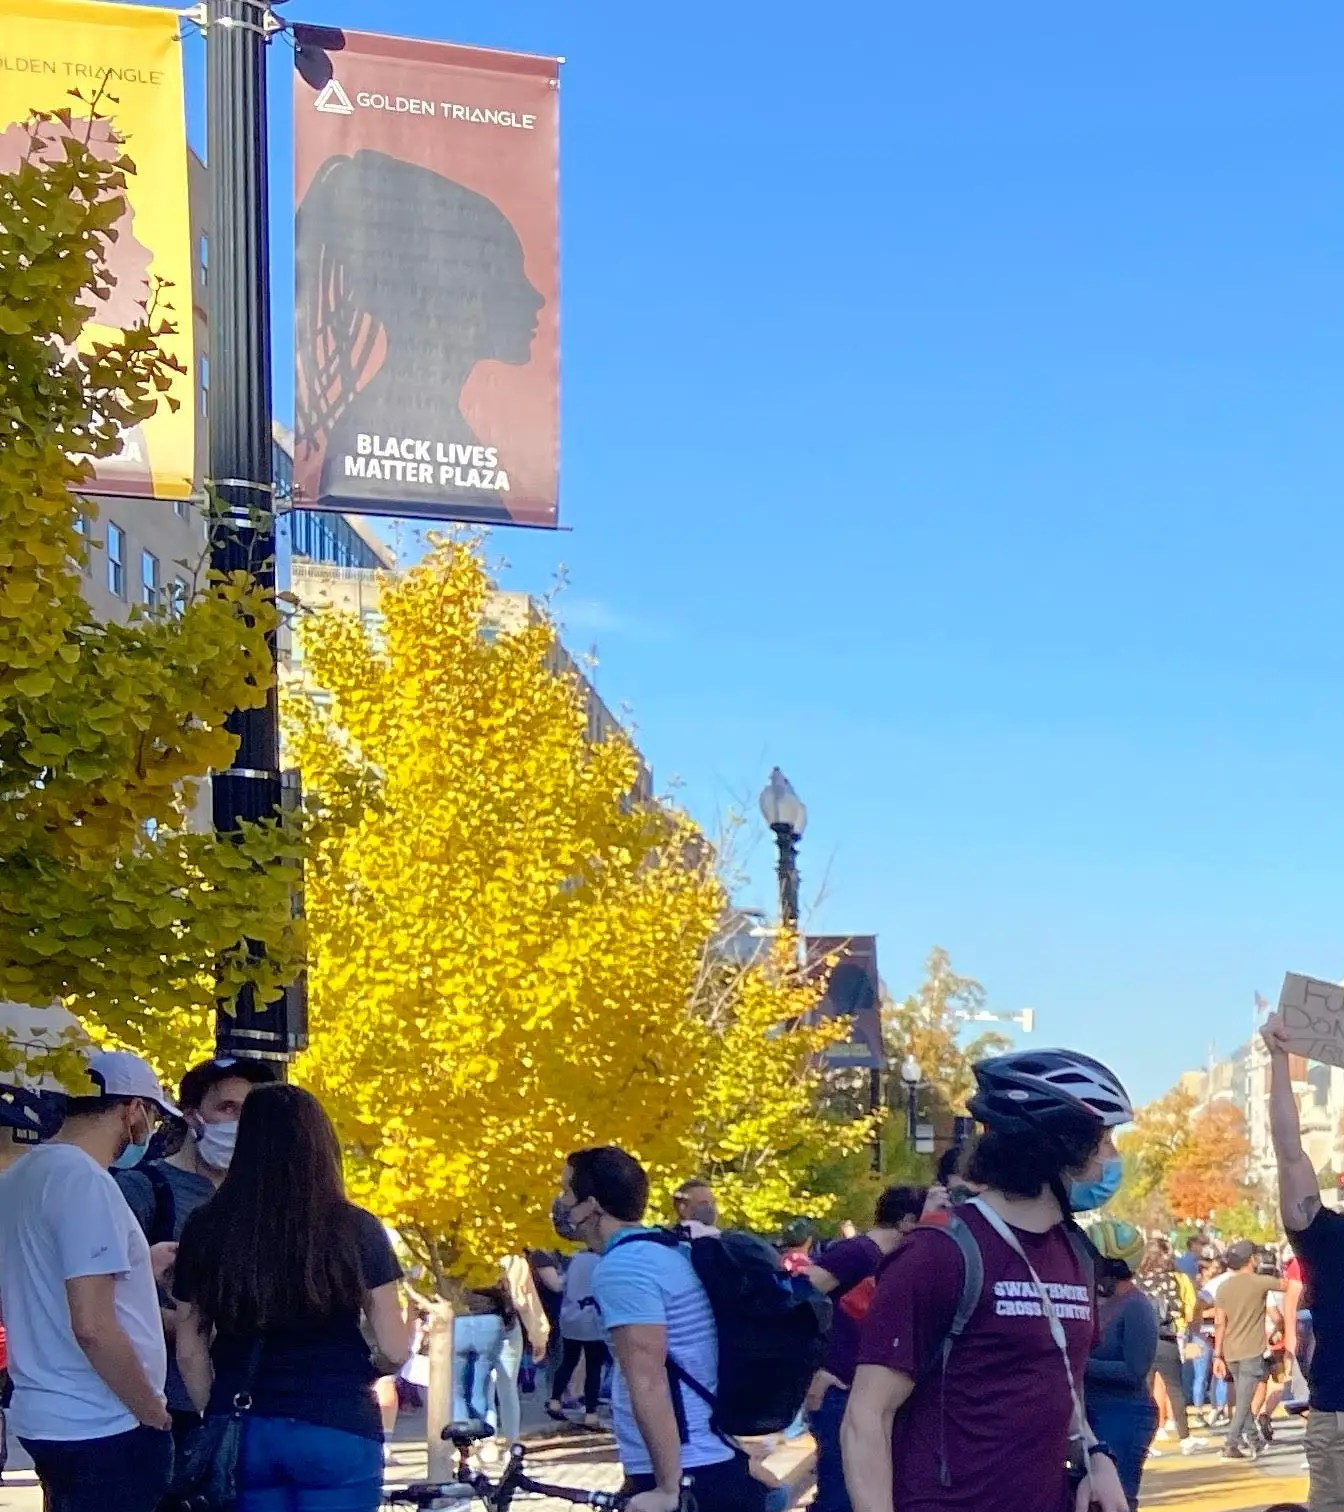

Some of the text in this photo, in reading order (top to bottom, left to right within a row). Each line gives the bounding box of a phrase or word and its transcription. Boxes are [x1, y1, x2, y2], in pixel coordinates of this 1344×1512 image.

[0, 56, 162, 85] LDEN TRIANGLE
[356, 92, 536, 129] GOLDEN TRIANGLE
[356, 433, 498, 468] BLACK LIVES
[344, 455, 511, 491] MATTER PLAZA
[996, 1300, 1042, 1317] CROSS
